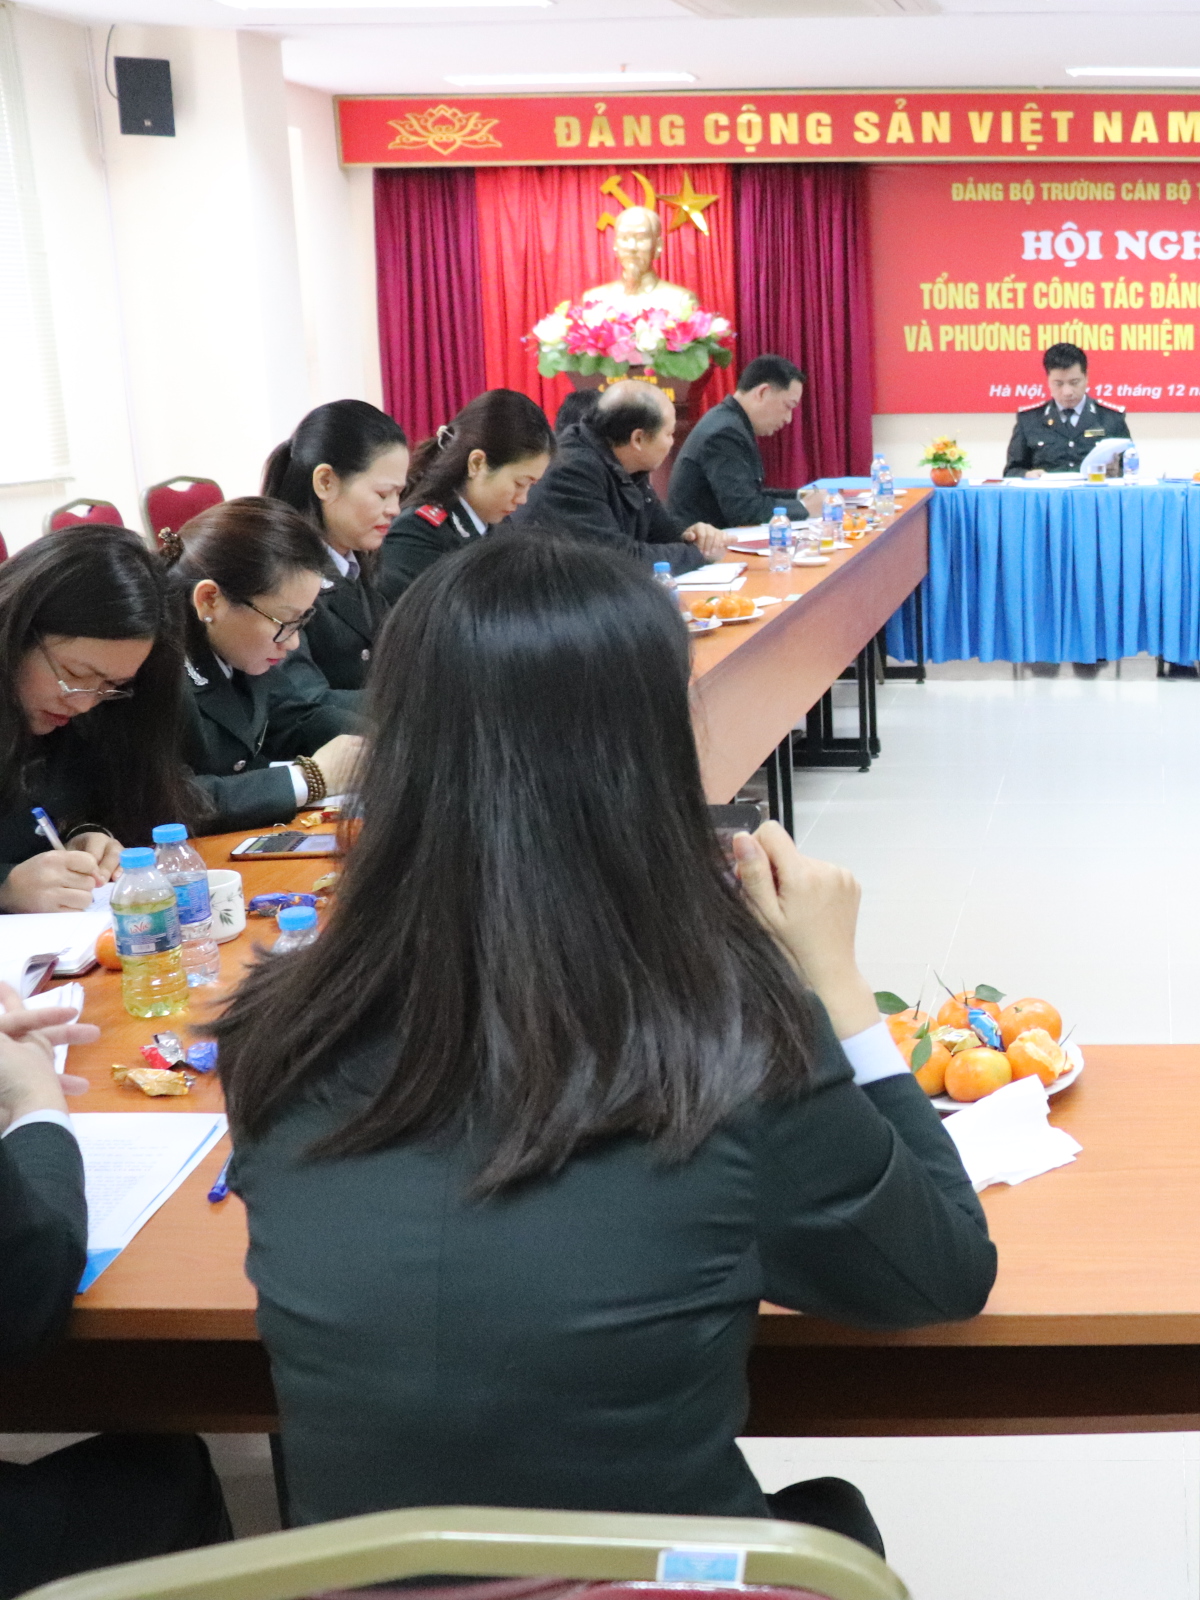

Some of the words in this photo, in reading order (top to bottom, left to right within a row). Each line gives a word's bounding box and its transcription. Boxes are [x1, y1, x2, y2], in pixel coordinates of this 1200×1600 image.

[553, 102, 686, 148] ĐẢNG
[703, 103, 833, 153] CỘNG
[852, 98, 951, 145] SẢN
[967, 102, 1074, 151] VIỆT
[950, 177, 1004, 202] ĐẢNG
[1009, 179, 1035, 205] BỘ
[1040, 178, 1116, 202] TRƯỜNG
[1121, 180, 1161, 202] CÁN
[1166, 179, 1192, 205] BỘ
[1021, 221, 1104, 268] HỘI
[919, 272, 980, 310] TỔNG
[986, 274, 1027, 310] KẾT
[1033, 275, 1095, 310] CÔNG
[1101, 276, 1144, 310] TÁC
[903, 319, 933, 353] VÀ
[939, 321, 1032, 352] PHƯƠNG
[1037, 318, 1115, 352] HƯỚNG
[1120, 318, 1196, 358] NHIỆM
[989, 384, 1012, 397] Hà
[1015, 384, 1046, 400] Nội,
[1095, 384, 1114, 397] 12
[1117, 384, 1162, 400] tháng
[1167, 384, 1185, 397] 12
